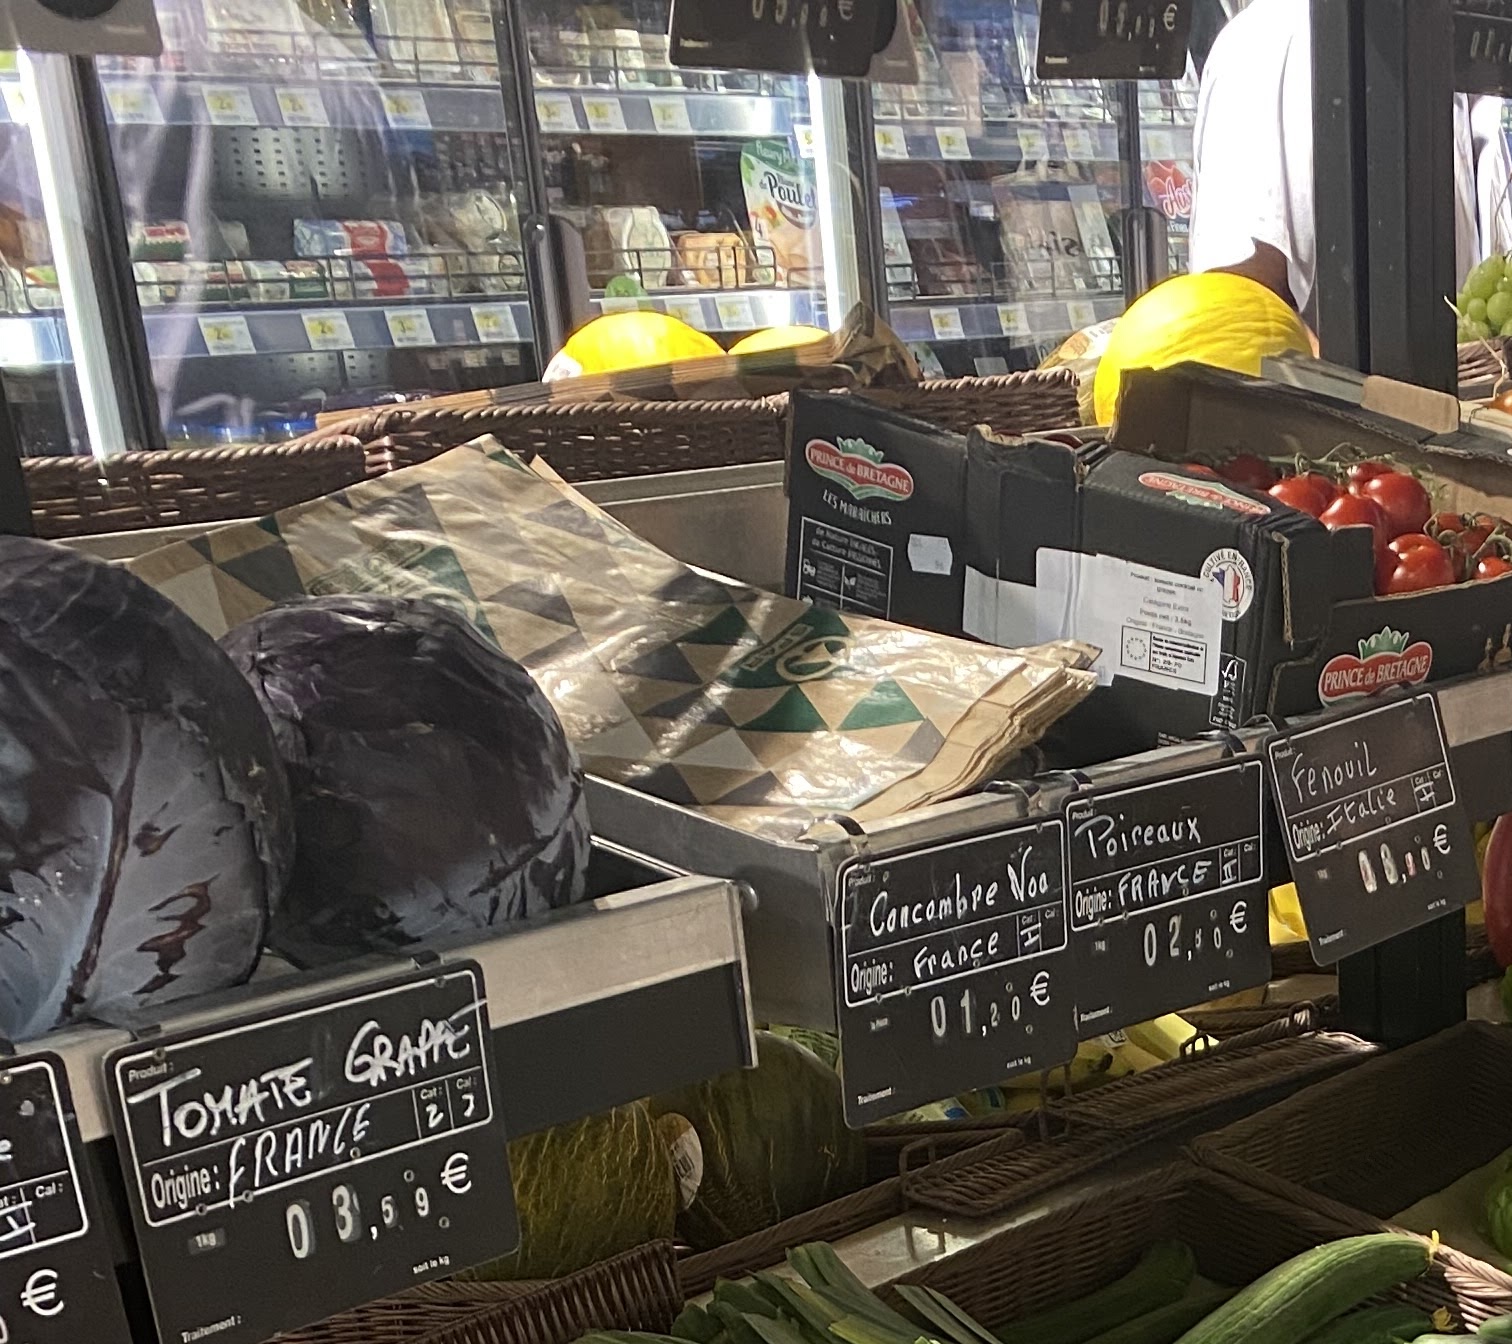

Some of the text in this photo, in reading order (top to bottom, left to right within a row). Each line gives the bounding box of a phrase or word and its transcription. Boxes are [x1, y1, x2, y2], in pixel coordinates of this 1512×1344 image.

[810, 447, 909, 493] PRINCE de BRETAGNE
[822, 489, 838, 509] LES
[1323, 653, 1429, 692] PRINCE de BRETAGNE
[1326, 787, 1397, 834] Italie
[1074, 813, 1202, 859] Poireaux
[1432, 824, 1451, 855] €
[1075, 886, 1113, 921] Origine:
[1117, 860, 1212, 907] FRANCE
[1229, 901, 1248, 934] €
[850, 959, 894, 996] Origine:
[912, 930, 1000, 980] France
[1029, 970, 1051, 1007] €
[127, 1057, 313, 1148] TOMATE
[151, 1162, 221, 1212] Origine:
[227, 1102, 371, 1209] FRANCE
[440, 1151, 473, 1195] €
[20, 1267, 65, 1317] €
